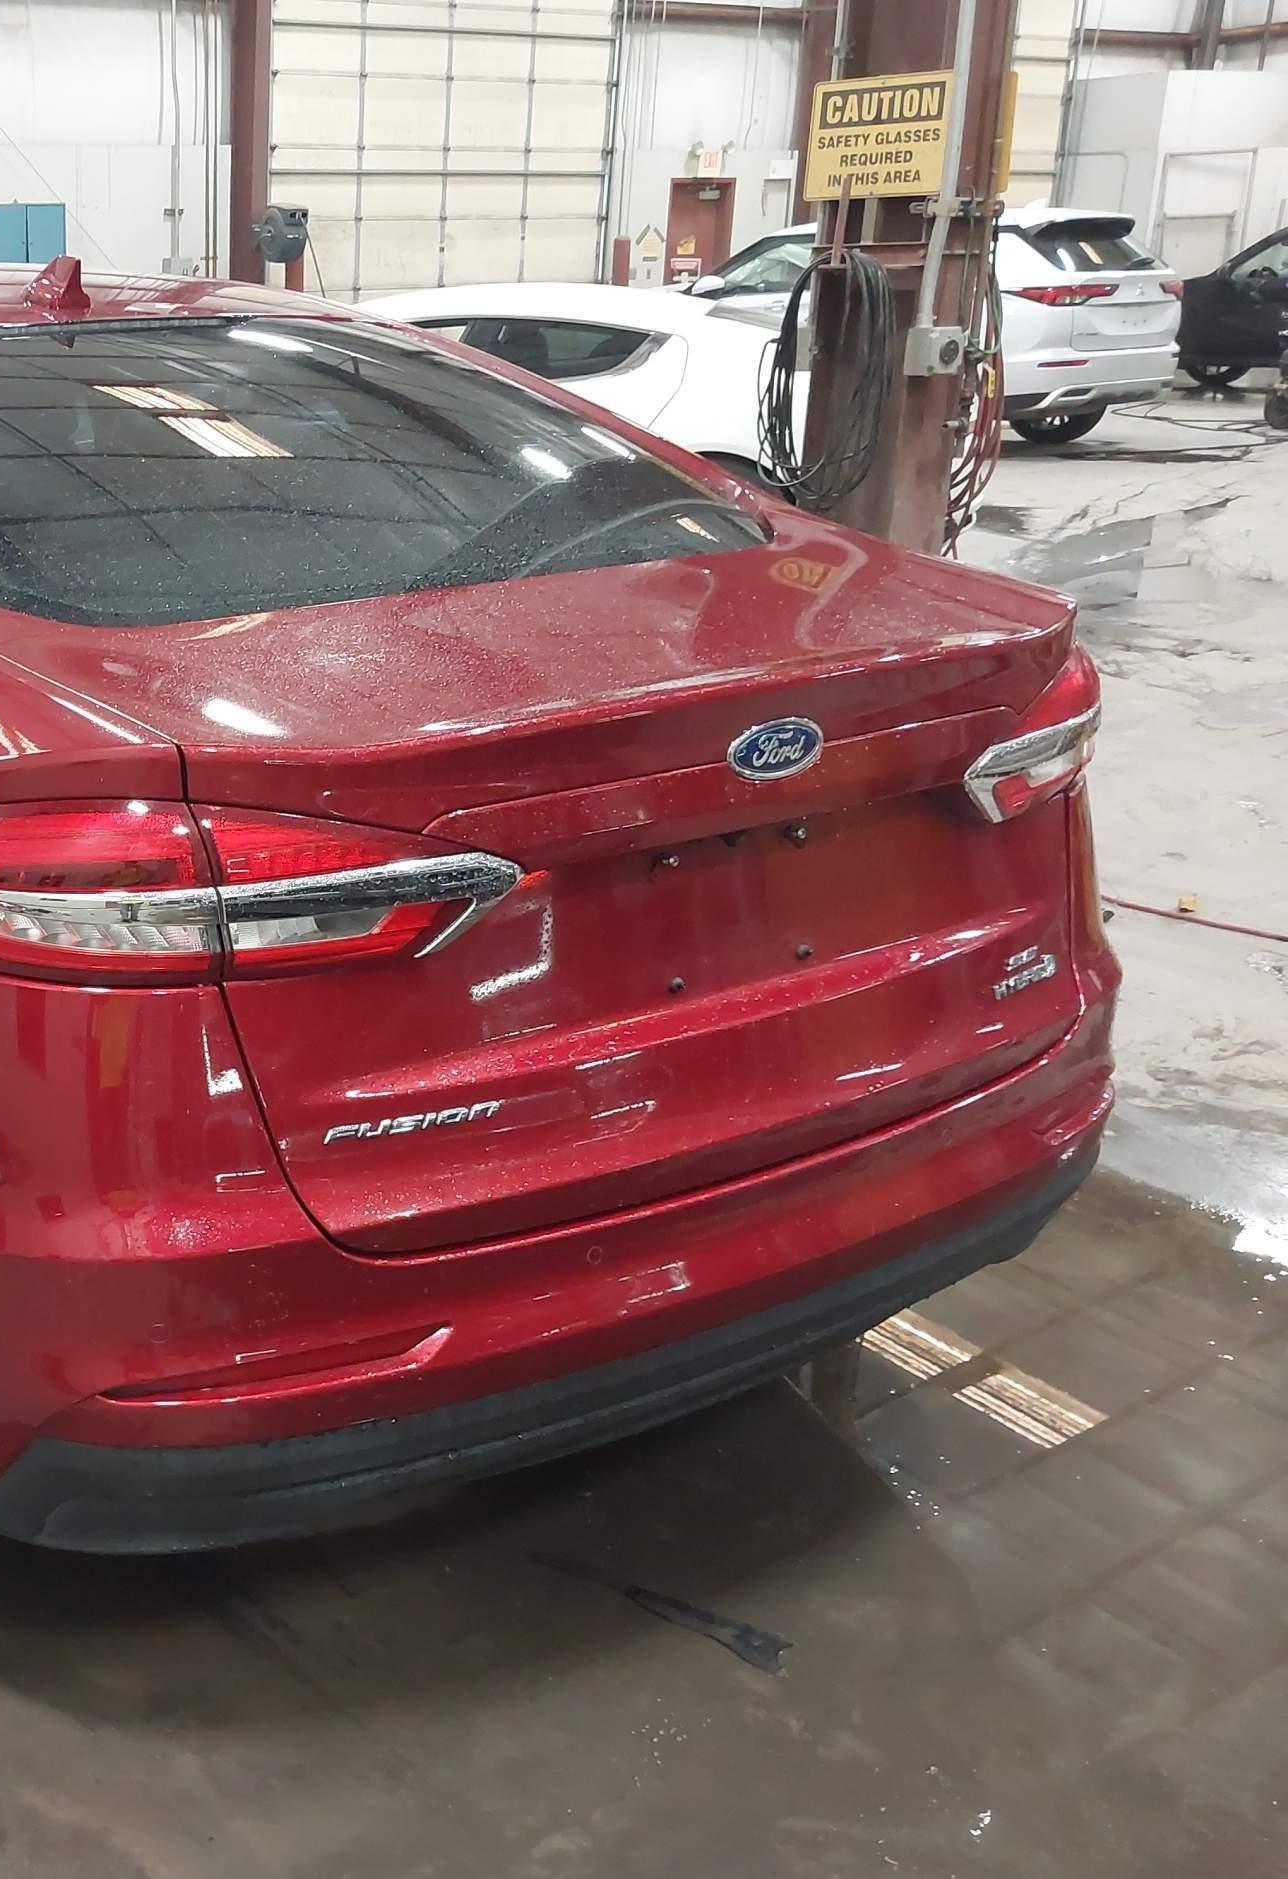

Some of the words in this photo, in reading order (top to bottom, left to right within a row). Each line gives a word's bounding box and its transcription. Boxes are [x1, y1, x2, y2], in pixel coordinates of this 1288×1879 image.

[826, 86, 941, 124] CAUTION
[818, 132, 870, 150] SAFETY
[875, 128, 941, 145] GLASSES
[839, 150, 913, 167] REQUIRED
[827, 173, 842, 187] IN
[883, 169, 921, 184] AREA
[752, 730, 806, 767] Ford
[323, 1100, 502, 1145] FUSION
